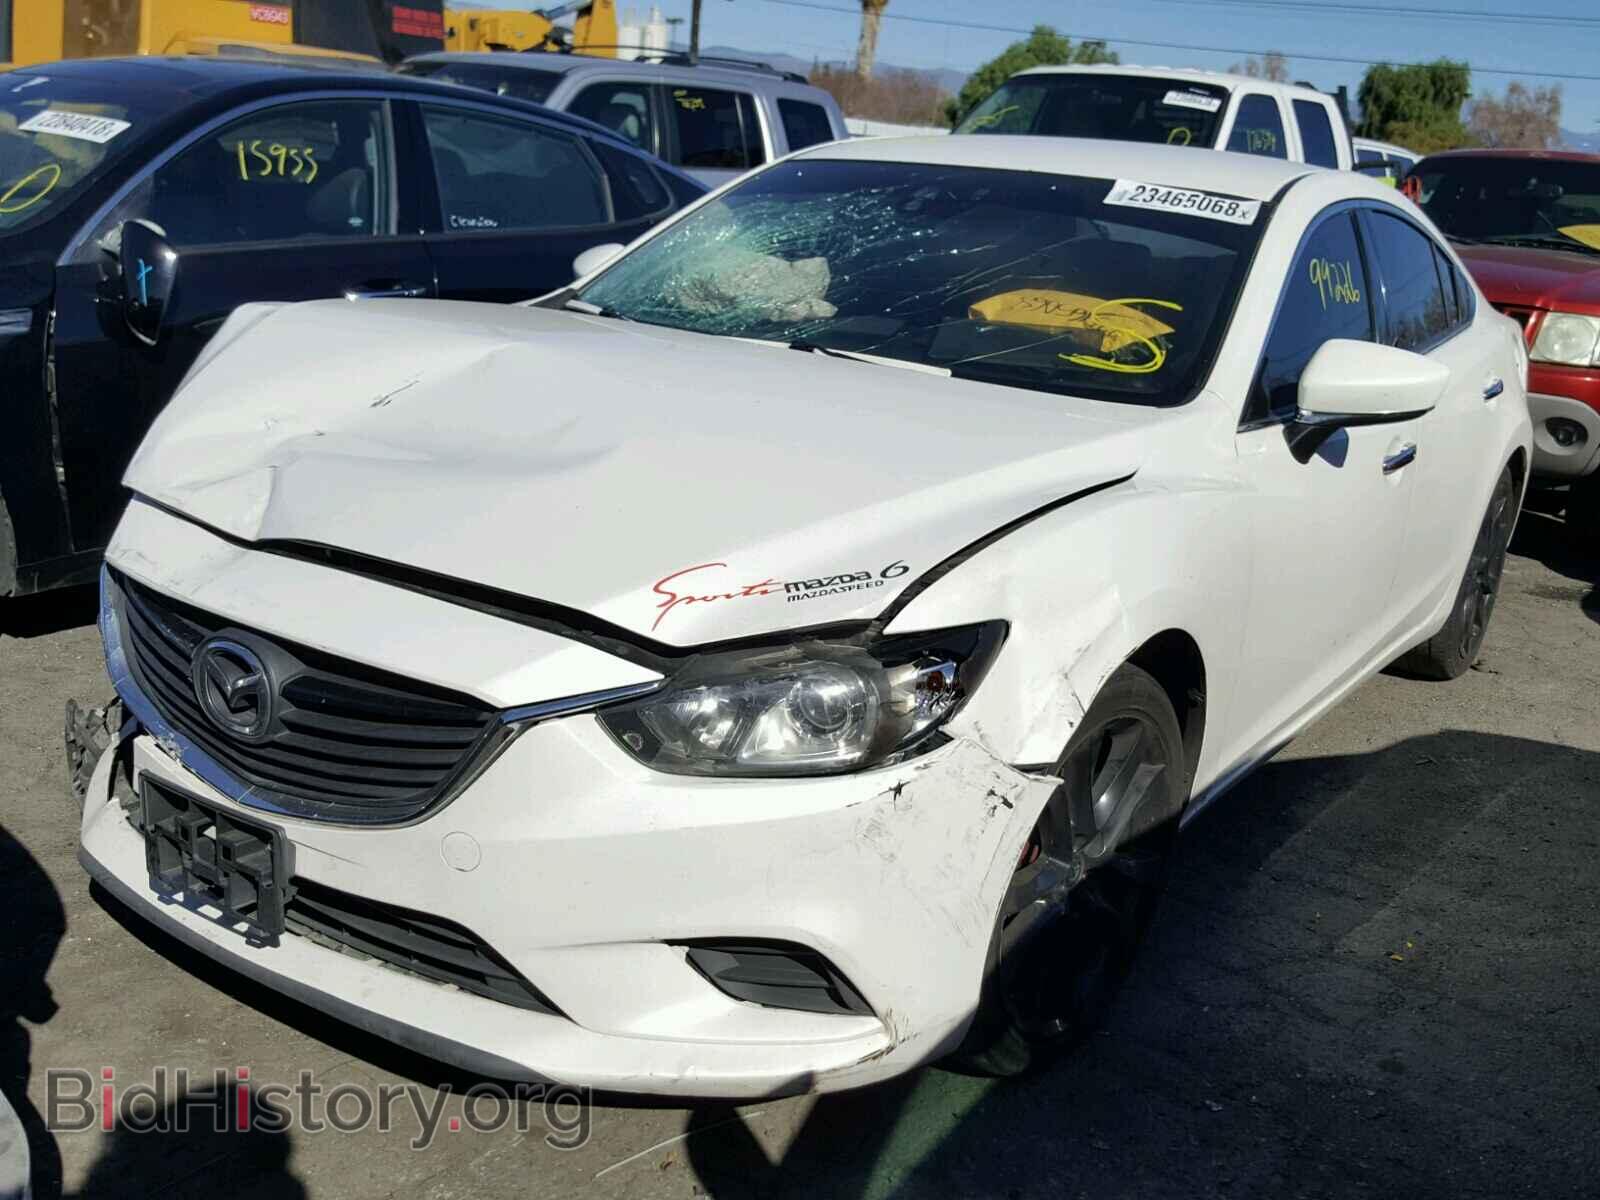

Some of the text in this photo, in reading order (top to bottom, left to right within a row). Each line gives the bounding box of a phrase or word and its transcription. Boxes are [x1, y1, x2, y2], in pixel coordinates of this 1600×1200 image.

[237, 140, 319, 184] 15955
[880, 560, 910, 579] 6
[786, 579, 884, 603] MAZDASPEED
